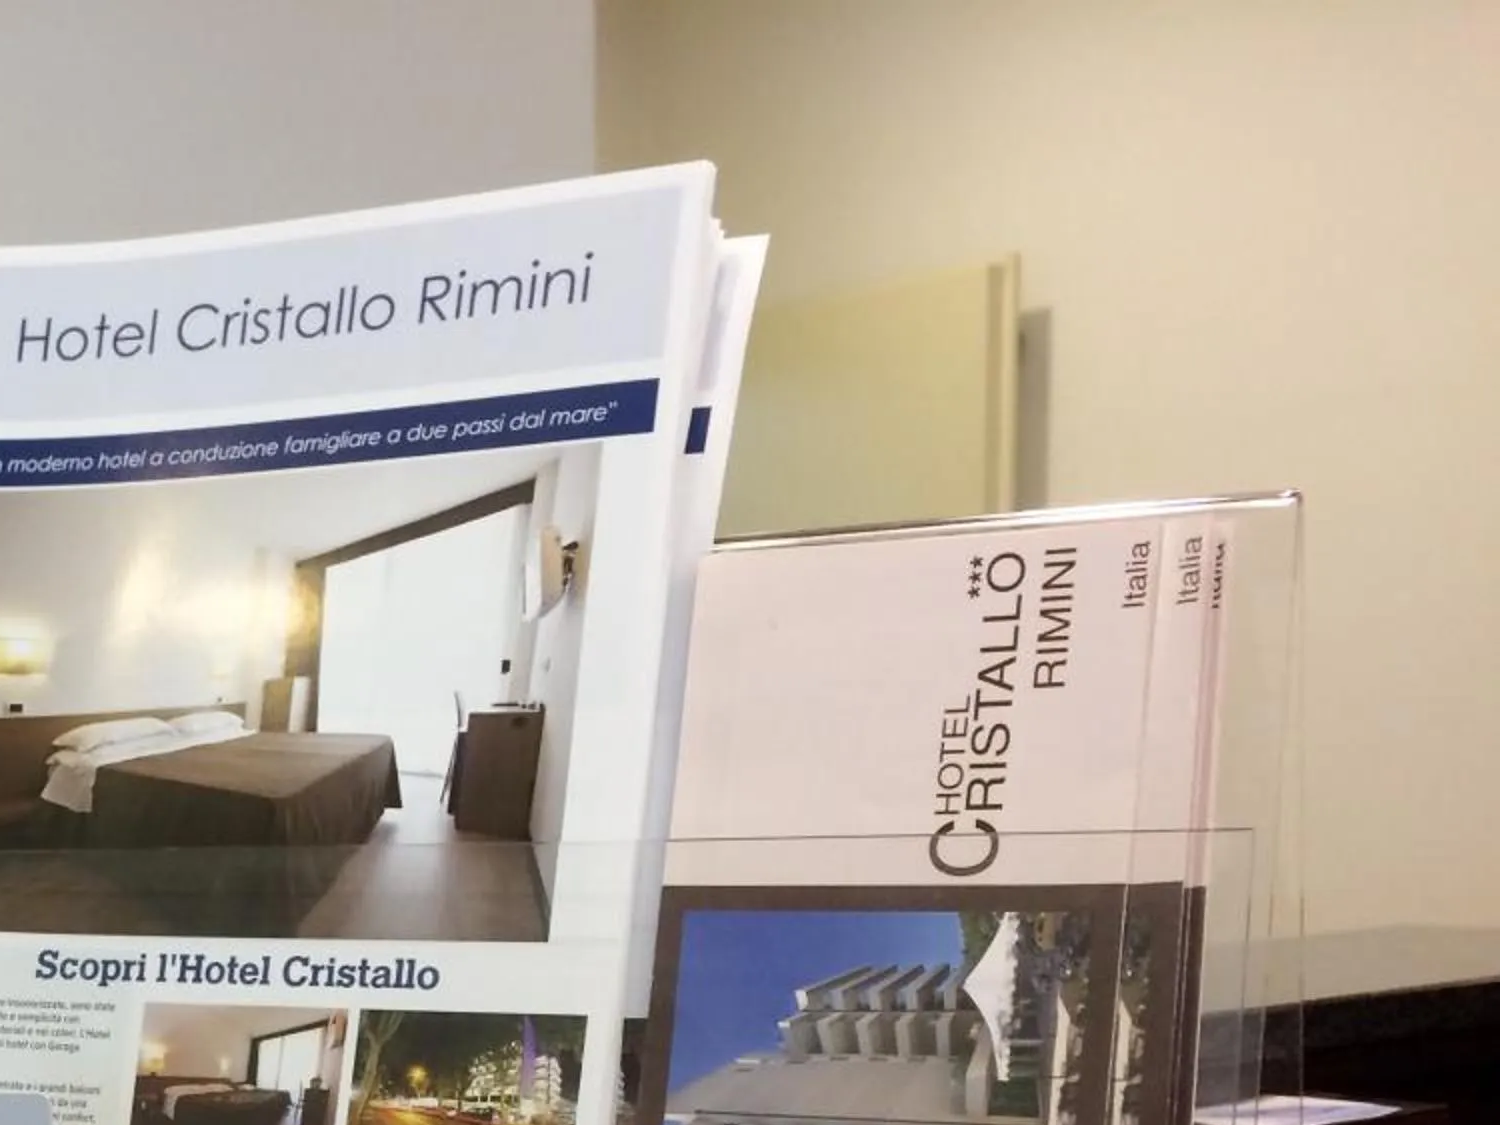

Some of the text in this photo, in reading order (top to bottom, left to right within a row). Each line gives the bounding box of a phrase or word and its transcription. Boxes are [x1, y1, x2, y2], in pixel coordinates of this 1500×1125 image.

[16, 251, 595, 363] Hotel Cristallo Rimini
[7, 453, 94, 473] moderno
[98, 450, 146, 470] hotel
[150, 454, 163, 467] a
[167, 439, 277, 465] conduzione
[283, 429, 381, 455] famigliare
[387, 429, 401, 443] a
[407, 421, 448, 442] due
[451, 414, 506, 440] passi
[509, 408, 544, 431] dal
[549, 401, 618, 426] mare"
[1121, 540, 1151, 609] Italia
[1176, 535, 1203, 606] Italia
[1033, 547, 1077, 689] RIMINI
[929, 552, 1026, 876] CRISTALLO
[934, 695, 971, 816] HOTEL
[35, 950, 440, 990] Scopri l'Hotel Cristallo
